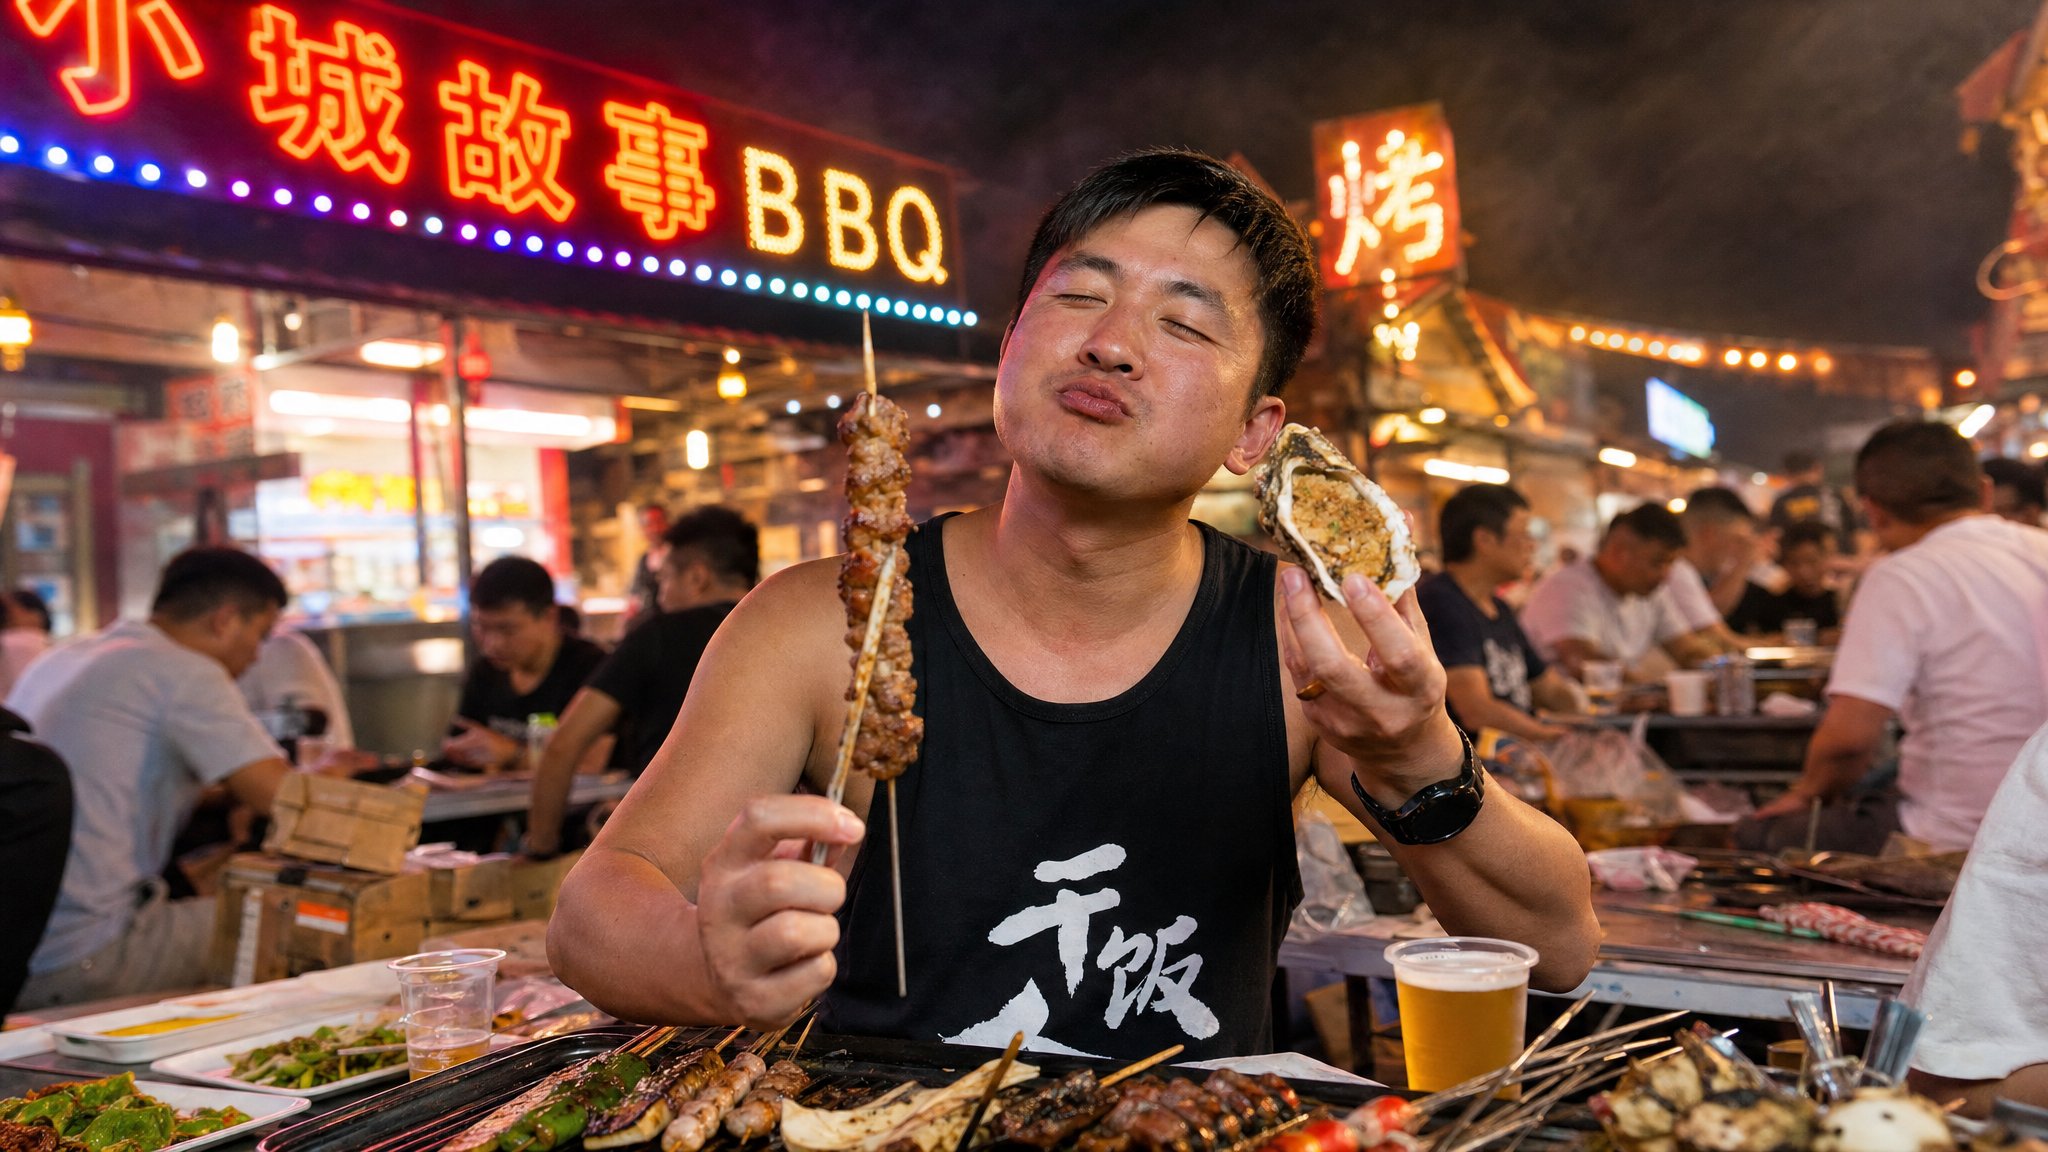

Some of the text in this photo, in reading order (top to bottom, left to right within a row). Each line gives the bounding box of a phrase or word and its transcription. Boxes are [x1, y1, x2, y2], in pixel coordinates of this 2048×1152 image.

[16, 0, 949, 285] 小城故事 BBQ
[1328, 129, 1444, 276] 烤
